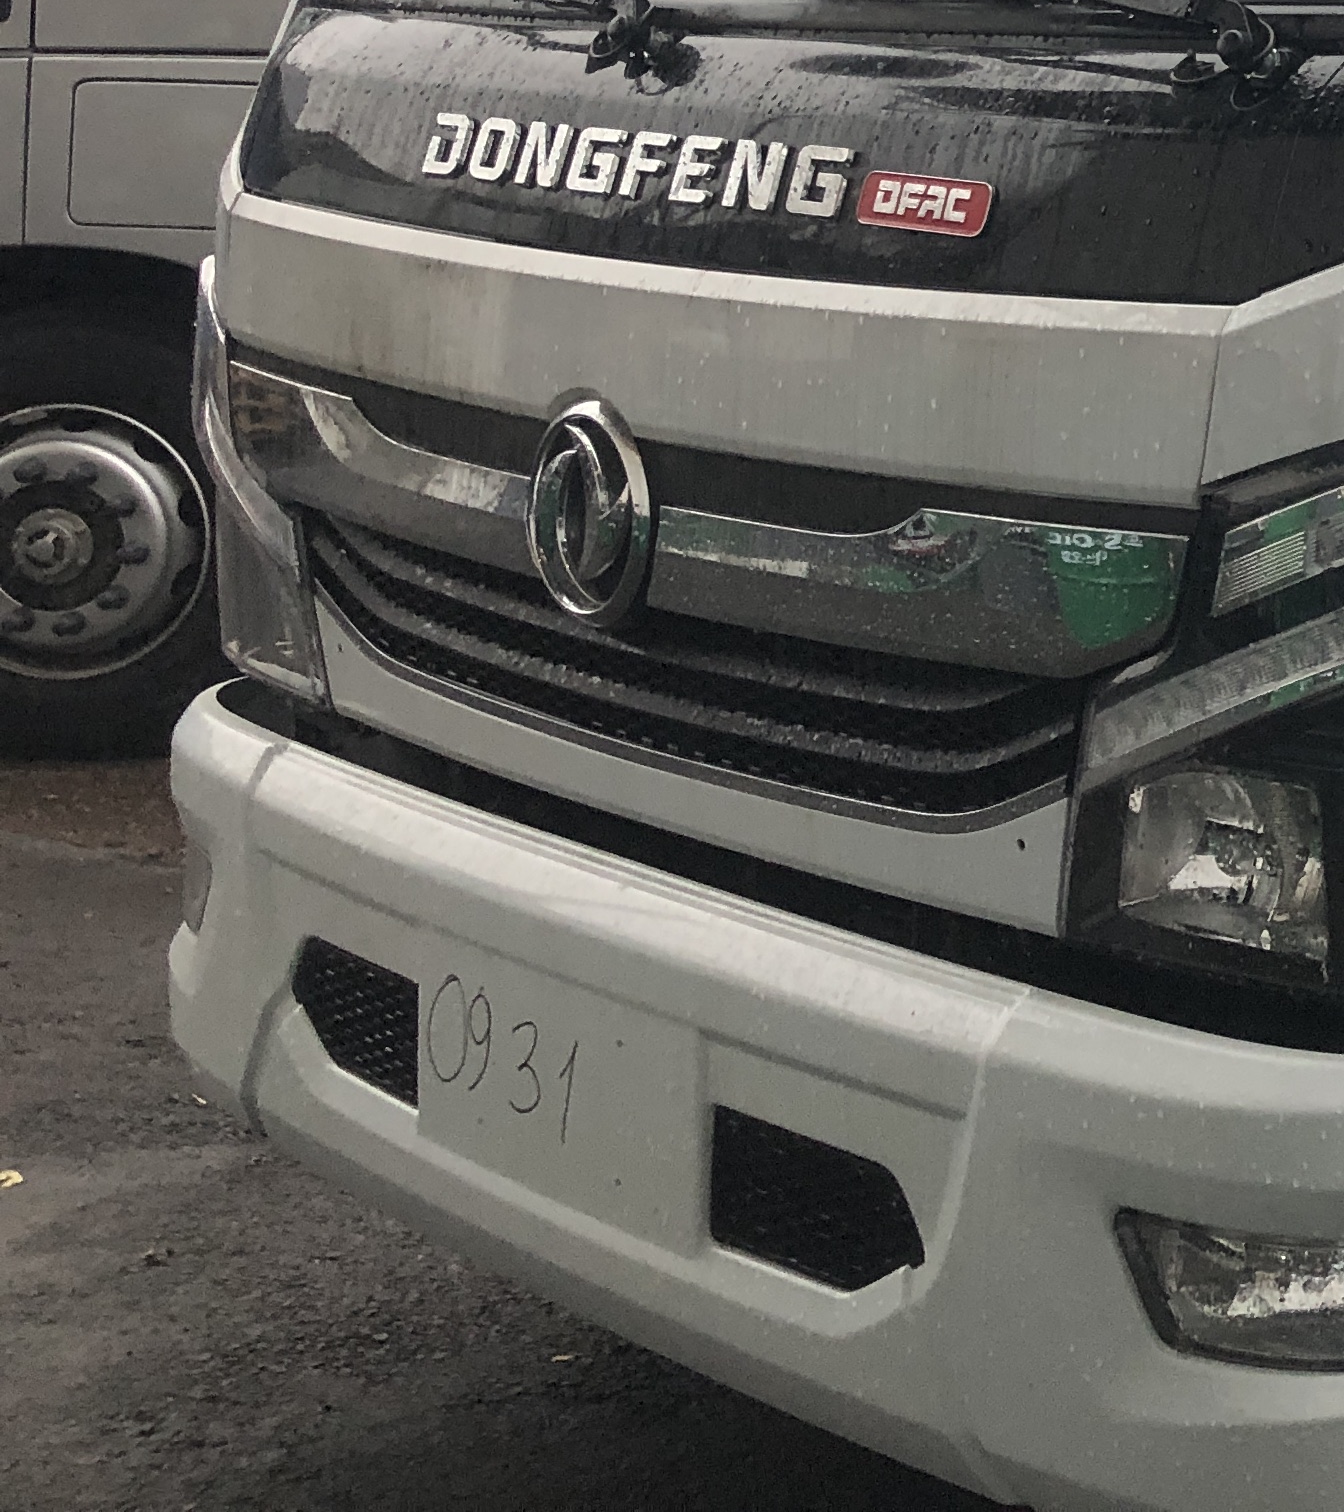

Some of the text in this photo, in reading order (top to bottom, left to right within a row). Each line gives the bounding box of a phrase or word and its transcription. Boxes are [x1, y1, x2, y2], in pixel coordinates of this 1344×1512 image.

[422, 111, 974, 224] DONGFENG DFAC
[427, 973, 578, 1144] 0931
